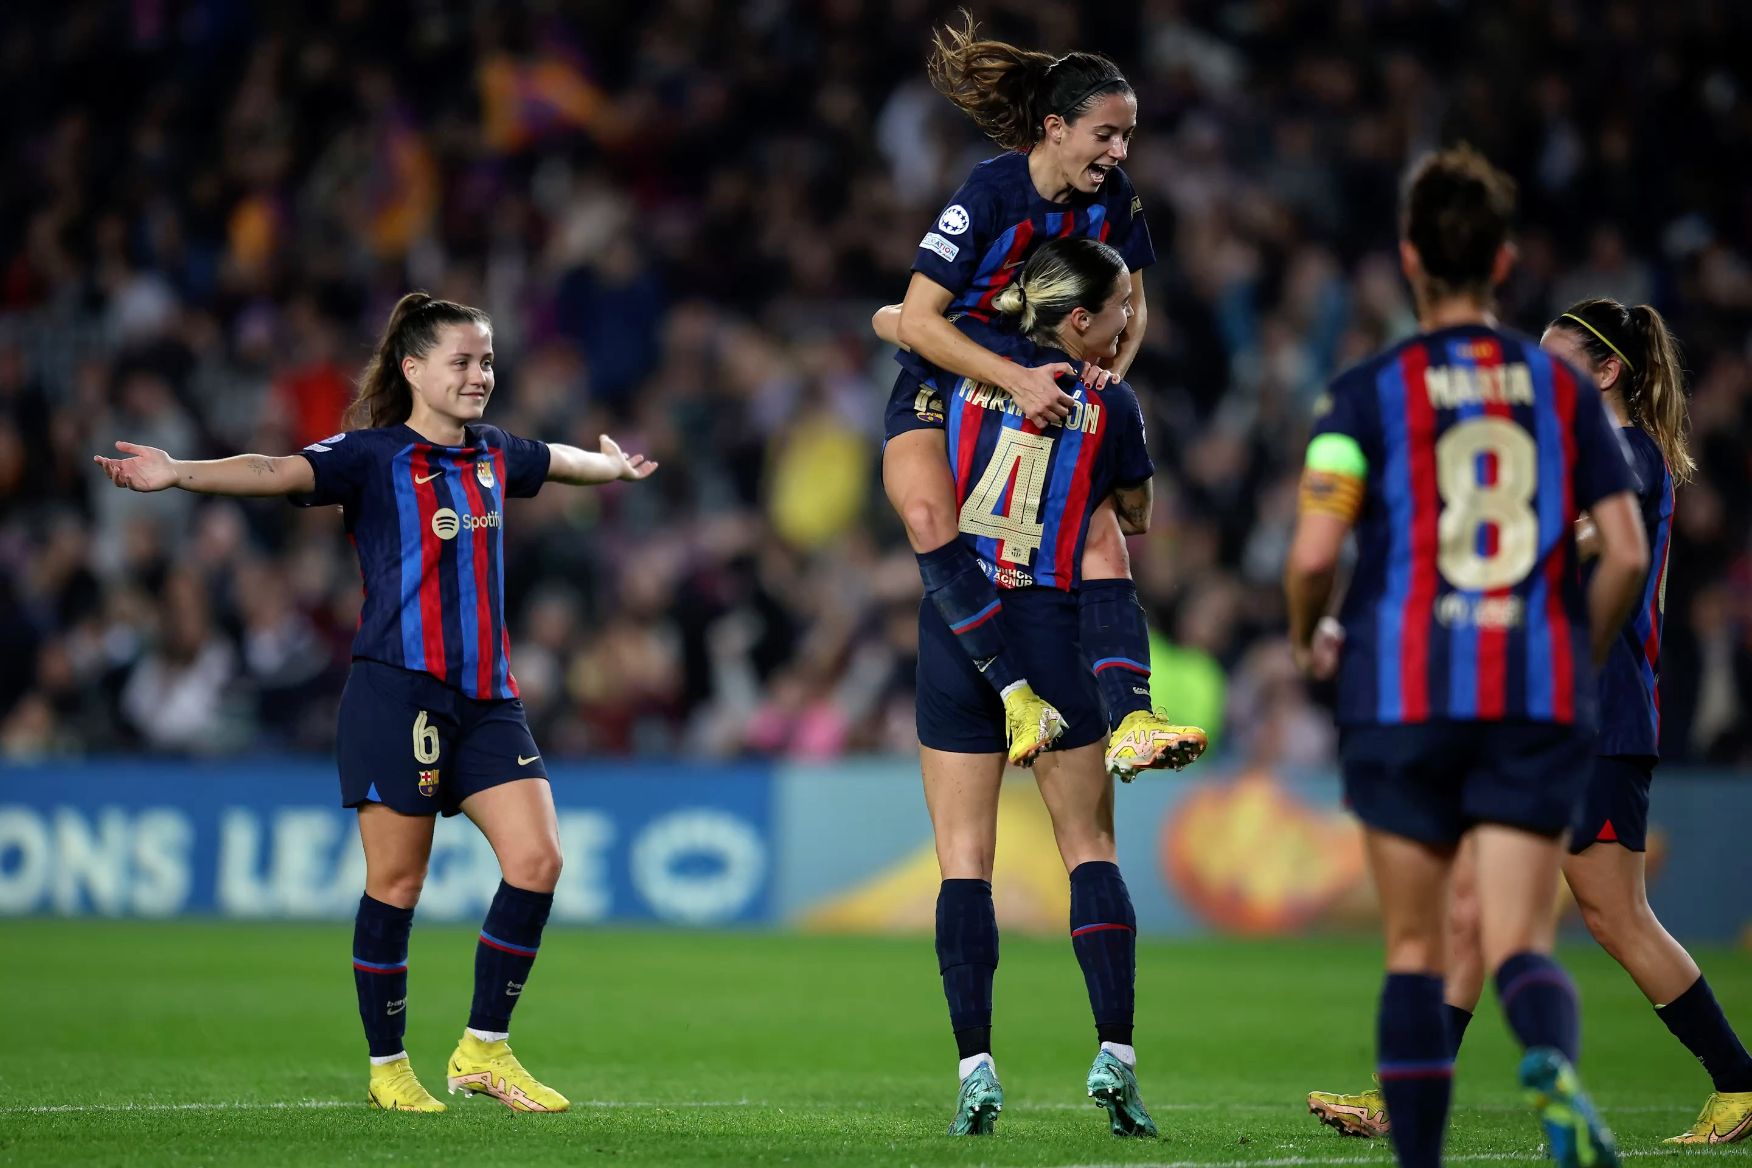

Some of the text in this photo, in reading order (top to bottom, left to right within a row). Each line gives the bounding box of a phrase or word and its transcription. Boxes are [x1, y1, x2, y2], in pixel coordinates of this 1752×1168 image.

[959, 377, 1025, 416] MAR
[958, 426, 1056, 567] 4
[1436, 416, 1540, 591] 8
[413, 710, 441, 765] 6
[217, 804, 618, 921] LEGE
